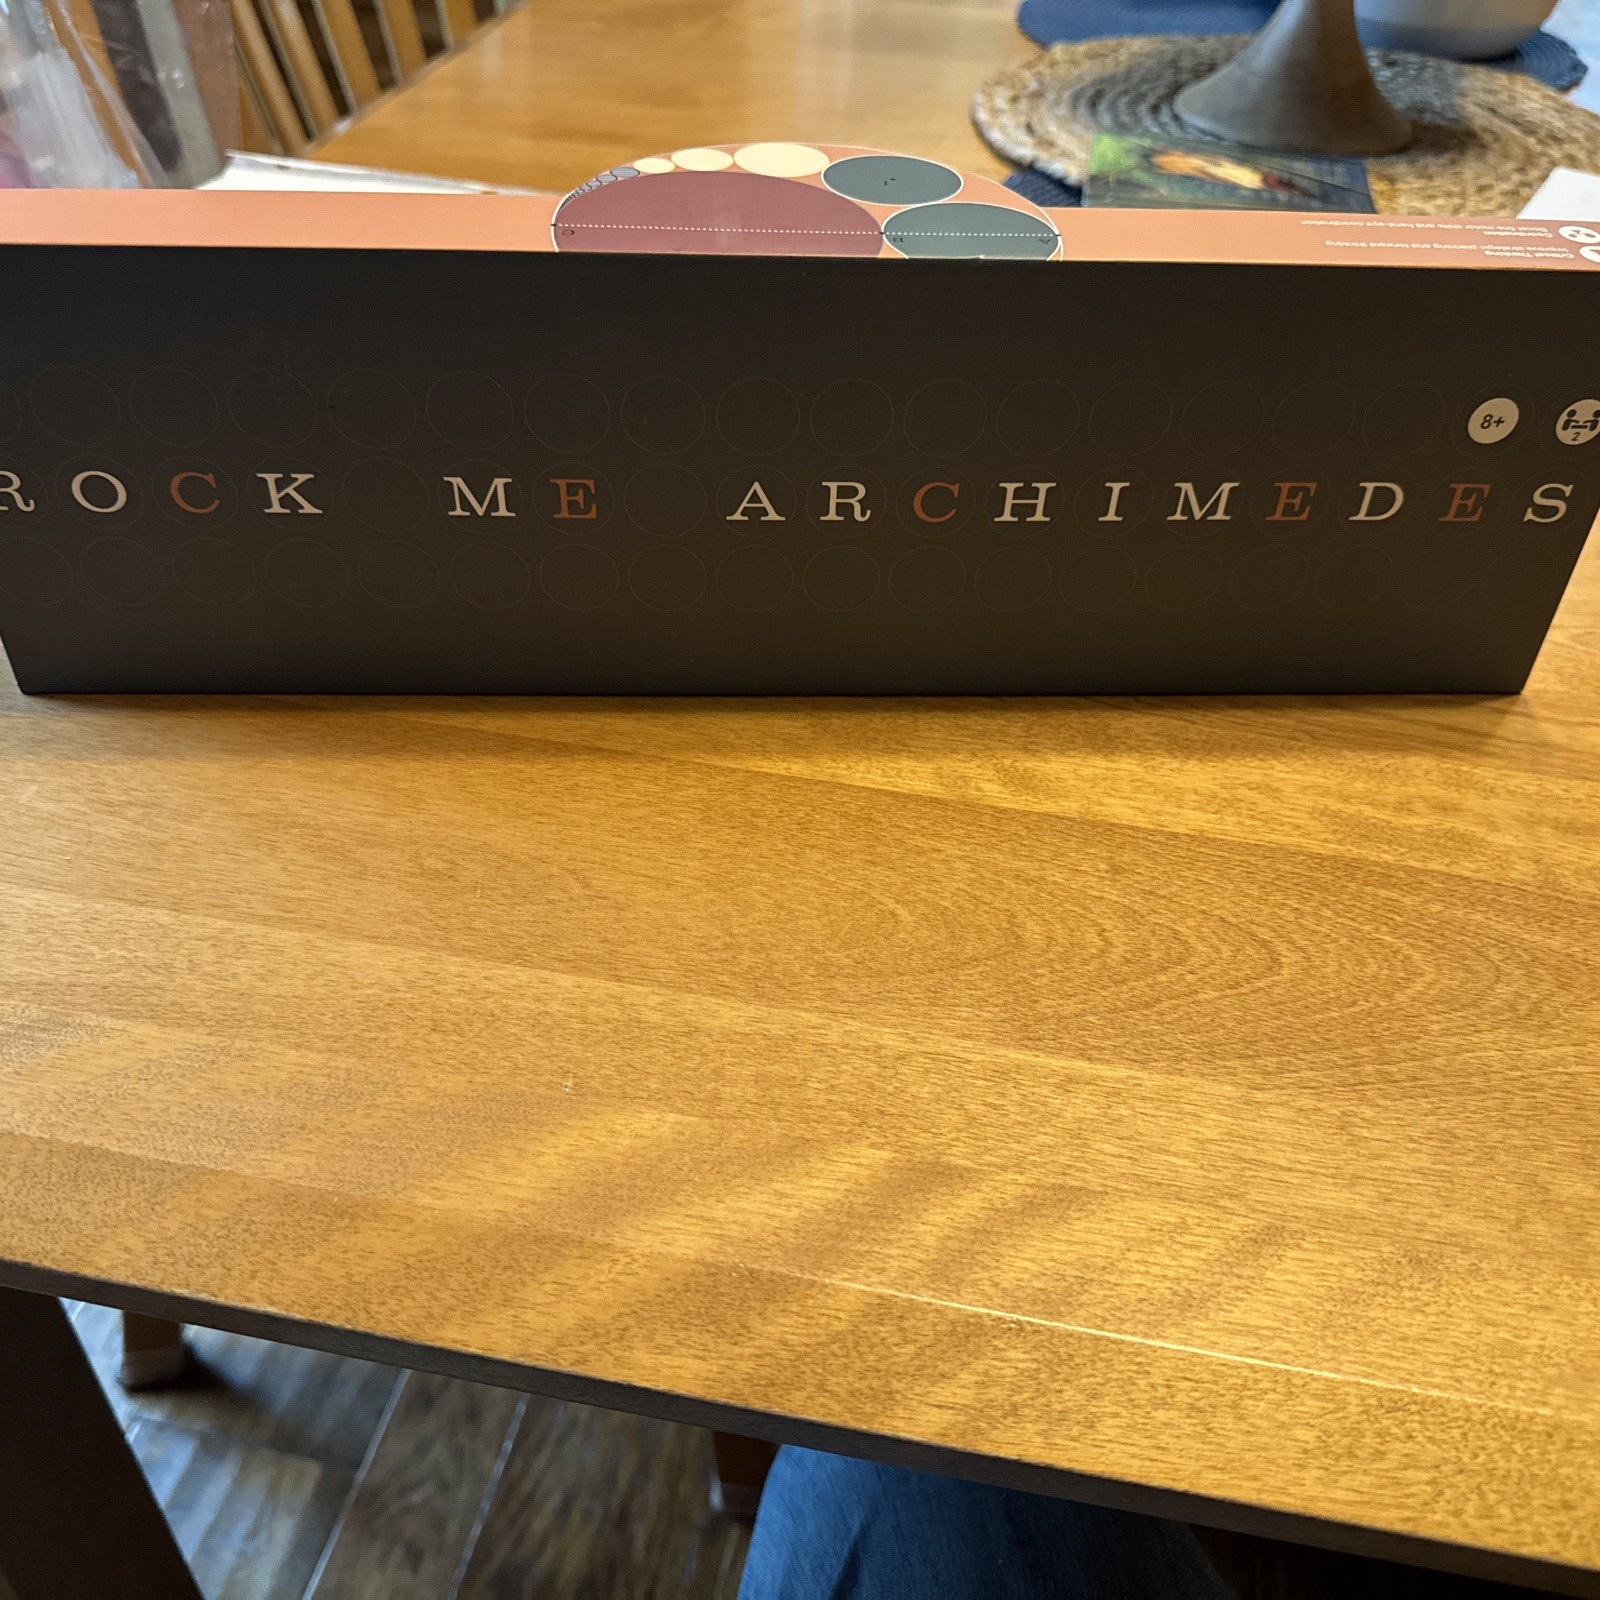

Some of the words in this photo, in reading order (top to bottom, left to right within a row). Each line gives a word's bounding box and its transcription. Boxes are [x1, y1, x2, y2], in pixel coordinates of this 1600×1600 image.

[1366, 220, 1415, 228] hand-eye
[1483, 230, 1554, 238] Coordination
[1325, 240, 1367, 248] thinking
[1433, 242, 1478, 250] planning
[1484, 250, 1533, 258] Thinking
[1480, 413, 1506, 430] 8+
[1571, 431, 1581, 442] 2
[0, 469, 323, 515] ROCK
[443, 475, 598, 521] ME
[726, 480, 1575, 525] ARCHIMEDES
